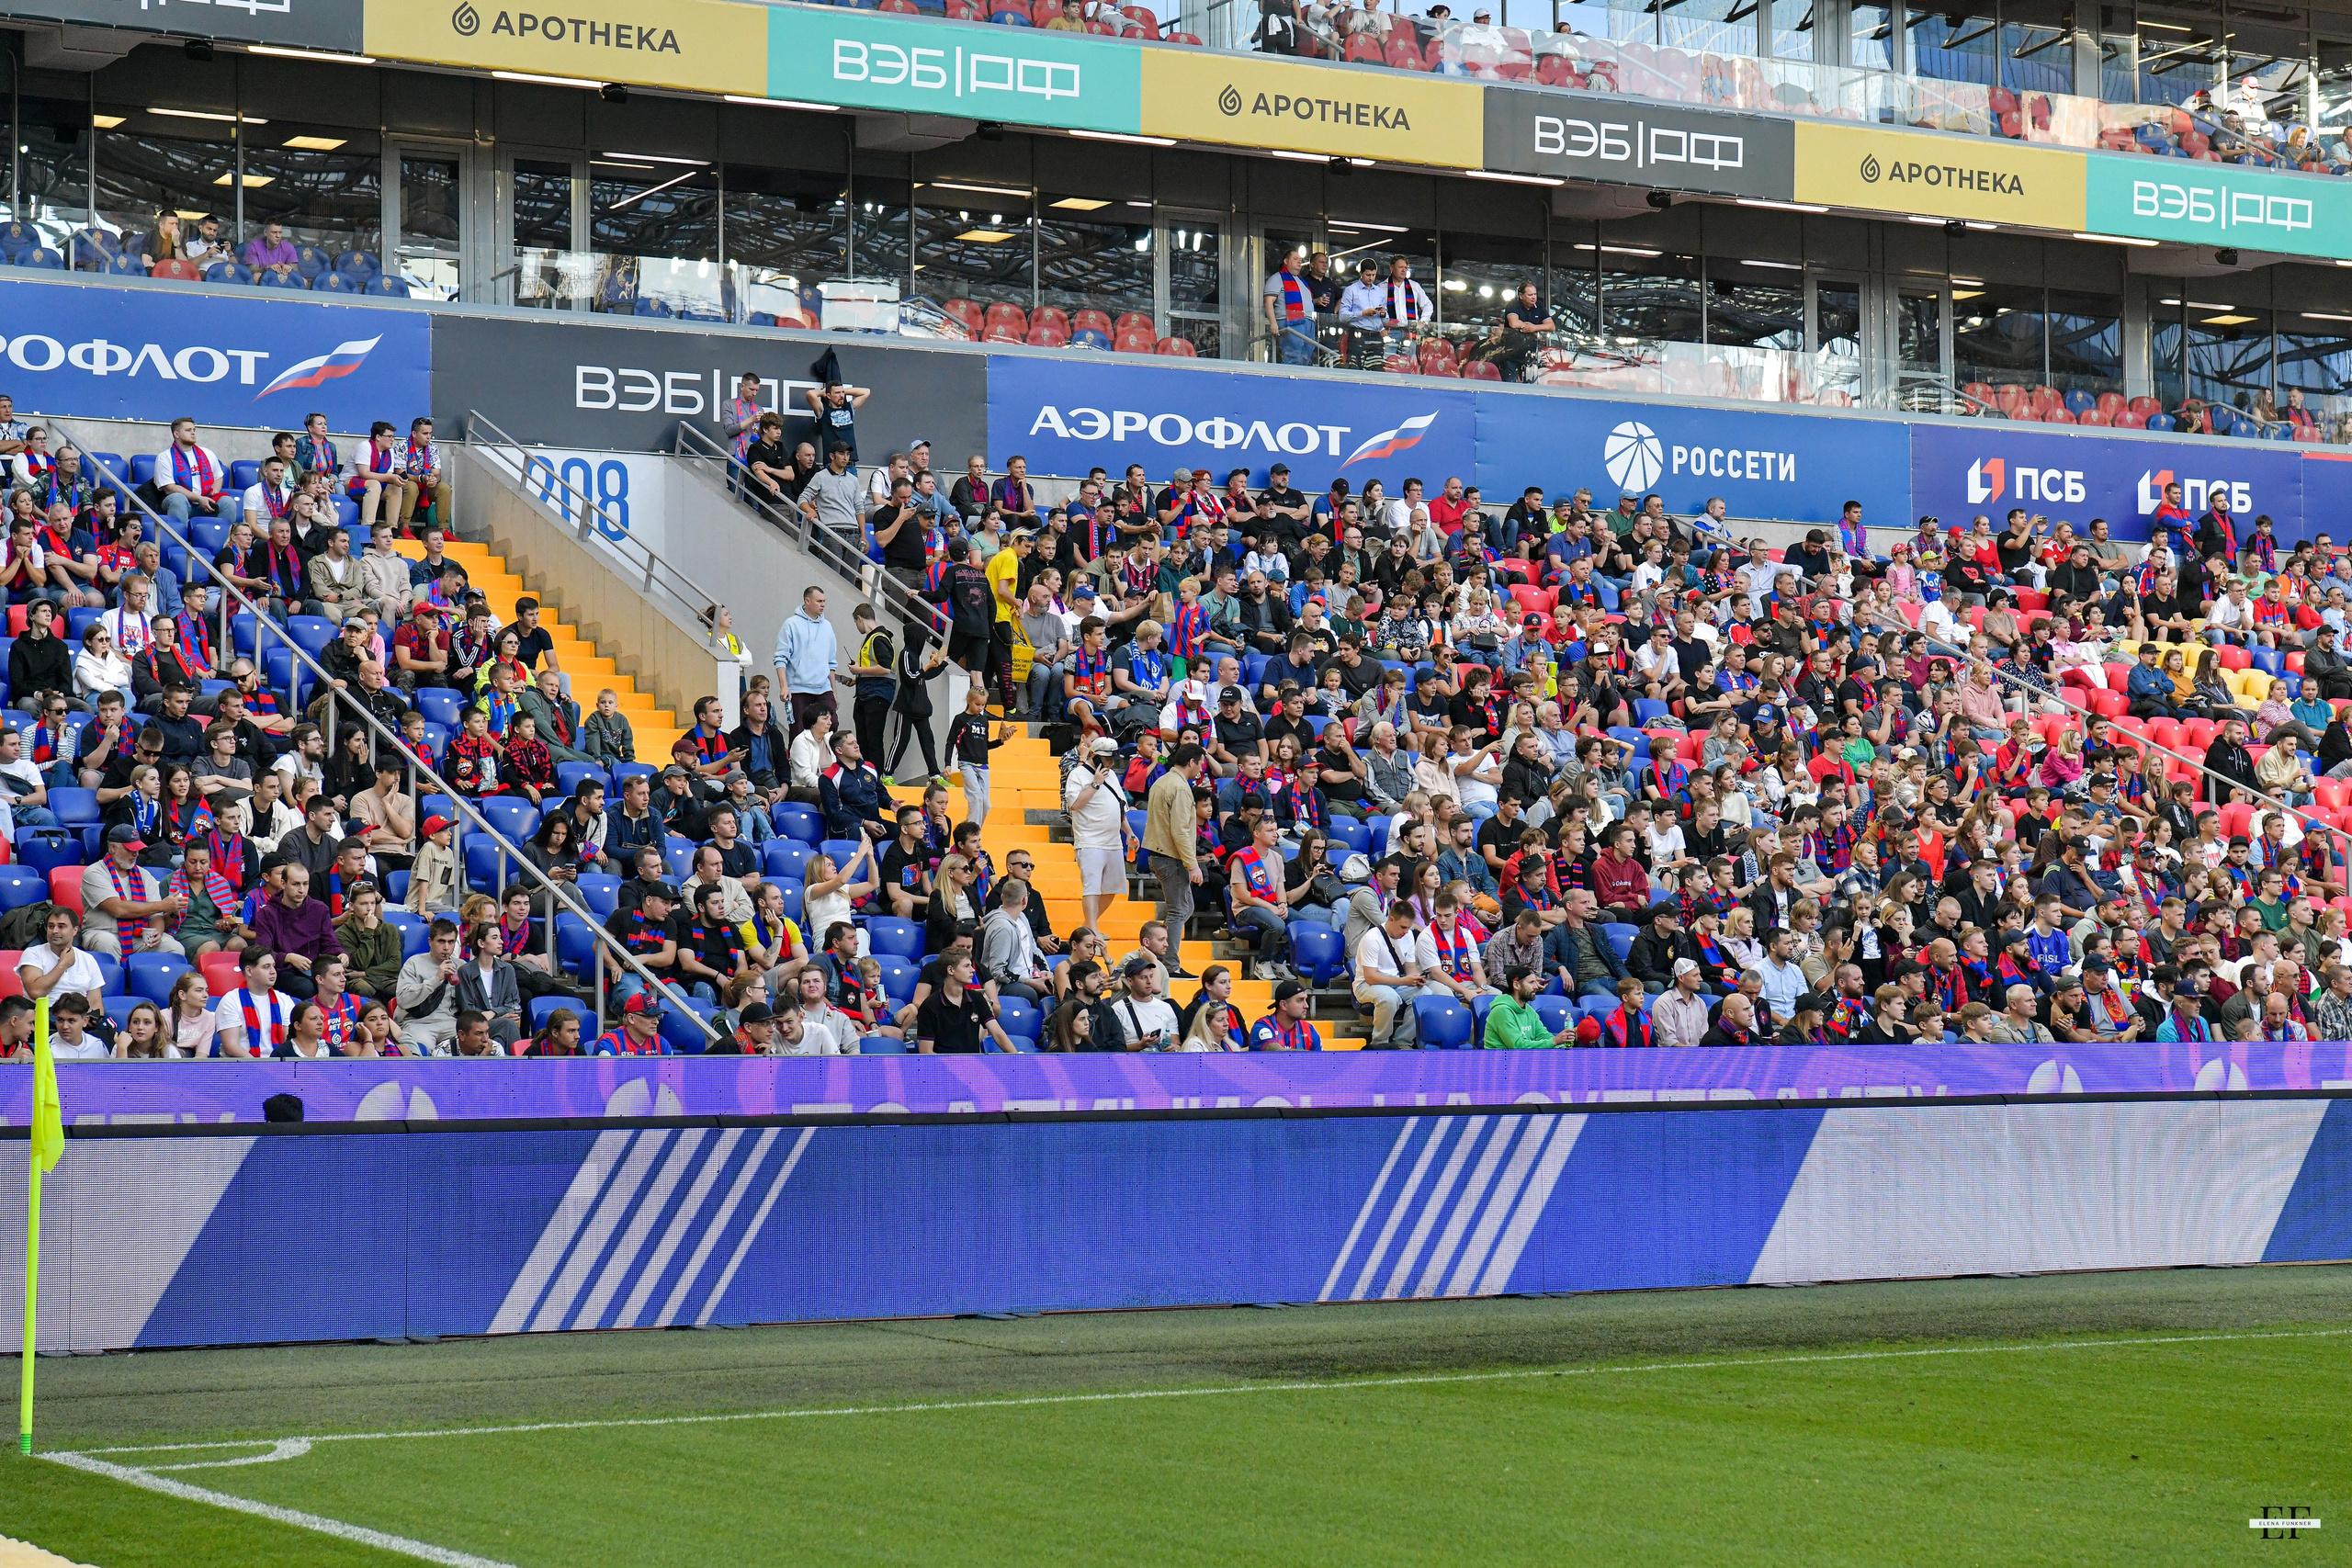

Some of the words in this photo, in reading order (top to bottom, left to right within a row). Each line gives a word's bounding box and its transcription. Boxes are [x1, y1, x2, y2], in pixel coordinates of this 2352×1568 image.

[492, 11, 681, 54] APOTHEKA
[1251, 93, 1411, 130] APOTHEKA
[1889, 161, 2024, 196] APOTHEKA
[0, 334, 269, 385] ОФЛОТ
[1029, 405, 1351, 456] АЭРОФЛОТ
[1672, 446, 1795, 482] РОССЕТИ
[2015, 467, 2086, 503] ПСБ
[2184, 478, 2252, 513] ПСБ
[327, 1017, 341, 1025] FON
[328, 1022, 341, 1032] BET
